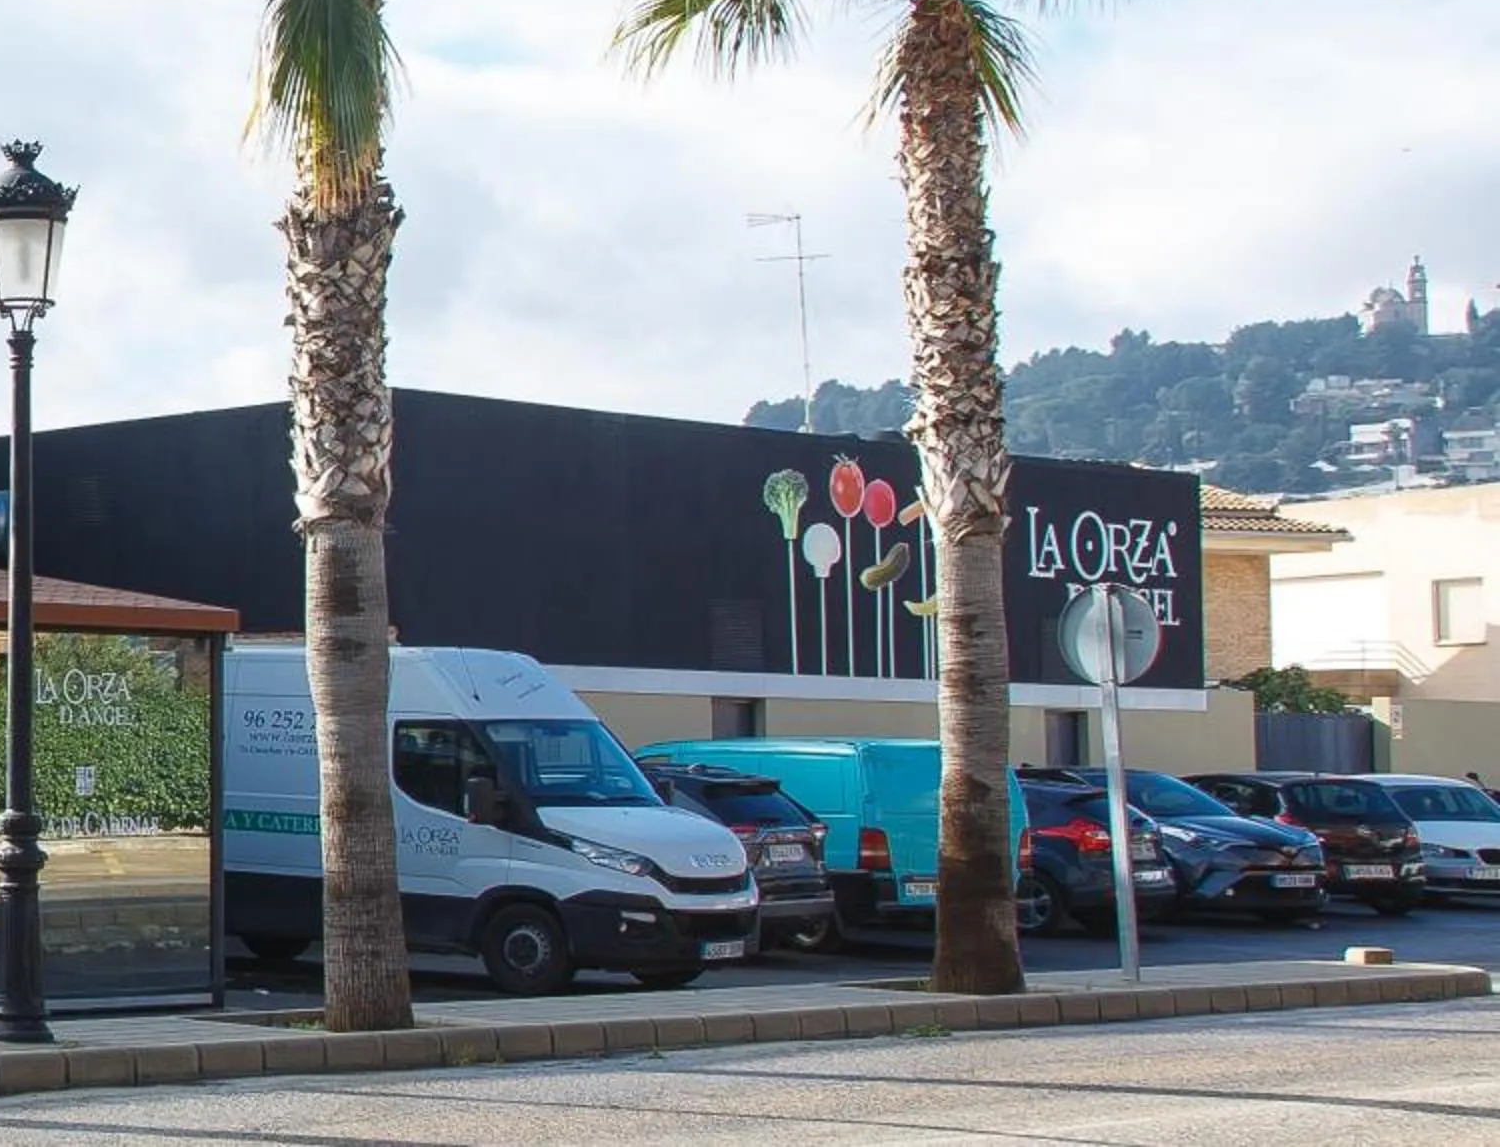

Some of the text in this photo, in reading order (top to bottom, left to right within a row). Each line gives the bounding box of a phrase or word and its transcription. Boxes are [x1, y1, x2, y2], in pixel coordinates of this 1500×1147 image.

[1025, 506, 1178, 584] LA ORZA
[35, 668, 134, 705] LA ORZA
[243, 710, 265, 729] 96
[269, 710, 305, 729] 252
[242, 812, 255, 829] Y
